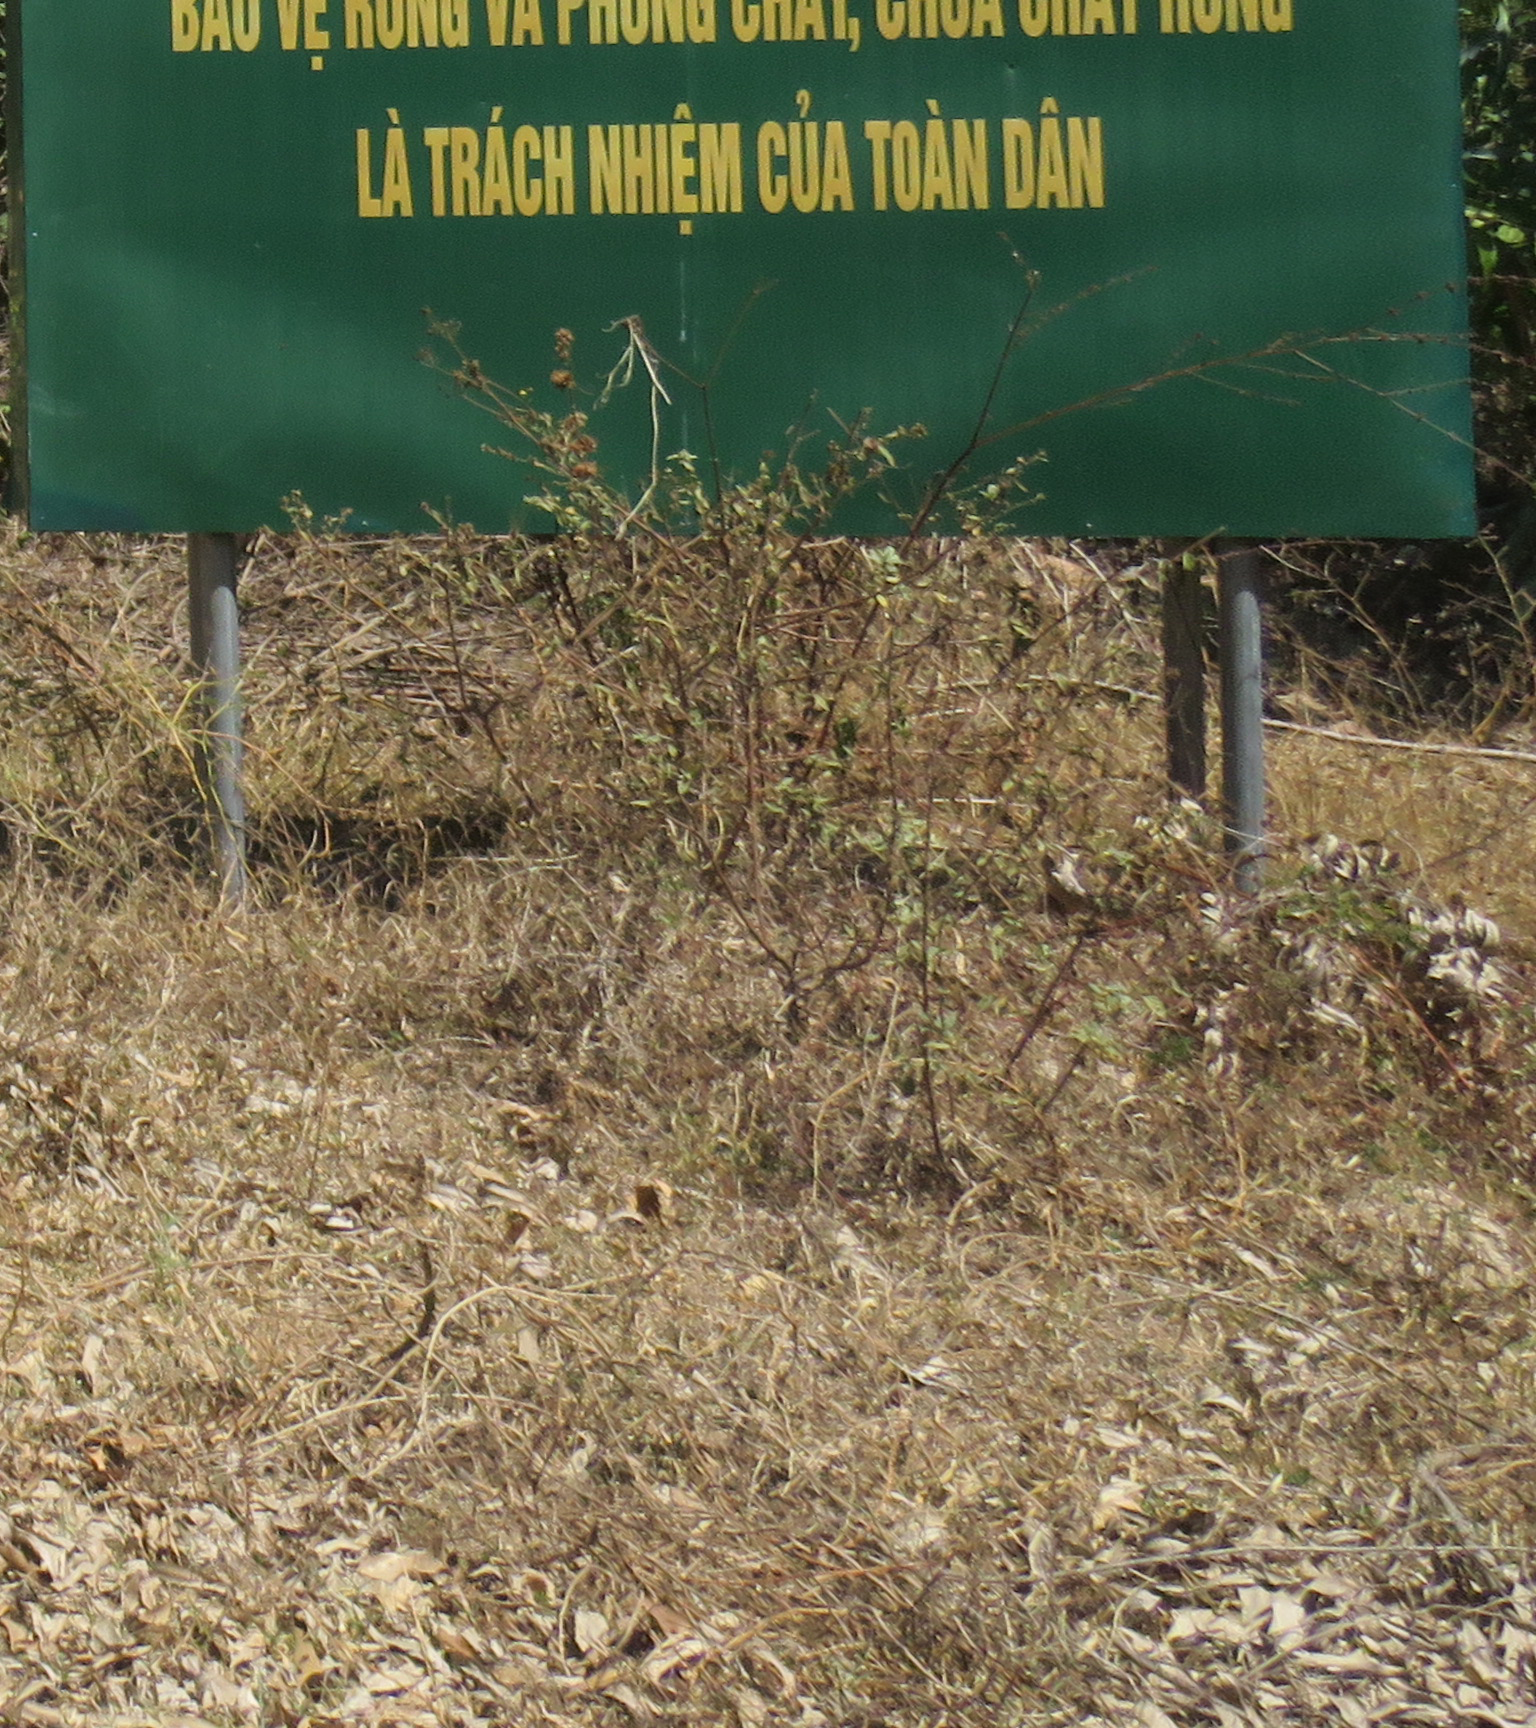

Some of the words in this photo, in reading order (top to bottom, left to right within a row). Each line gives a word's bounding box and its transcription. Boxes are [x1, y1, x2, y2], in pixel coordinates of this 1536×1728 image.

[356, 108, 414, 218] LÀ
[424, 106, 575, 217] TRÁCH
[588, 103, 743, 235] NHIỆM
[757, 89, 855, 214] CỦA
[864, 99, 989, 211] TOÀN
[1002, 97, 1105, 209] DÂN
